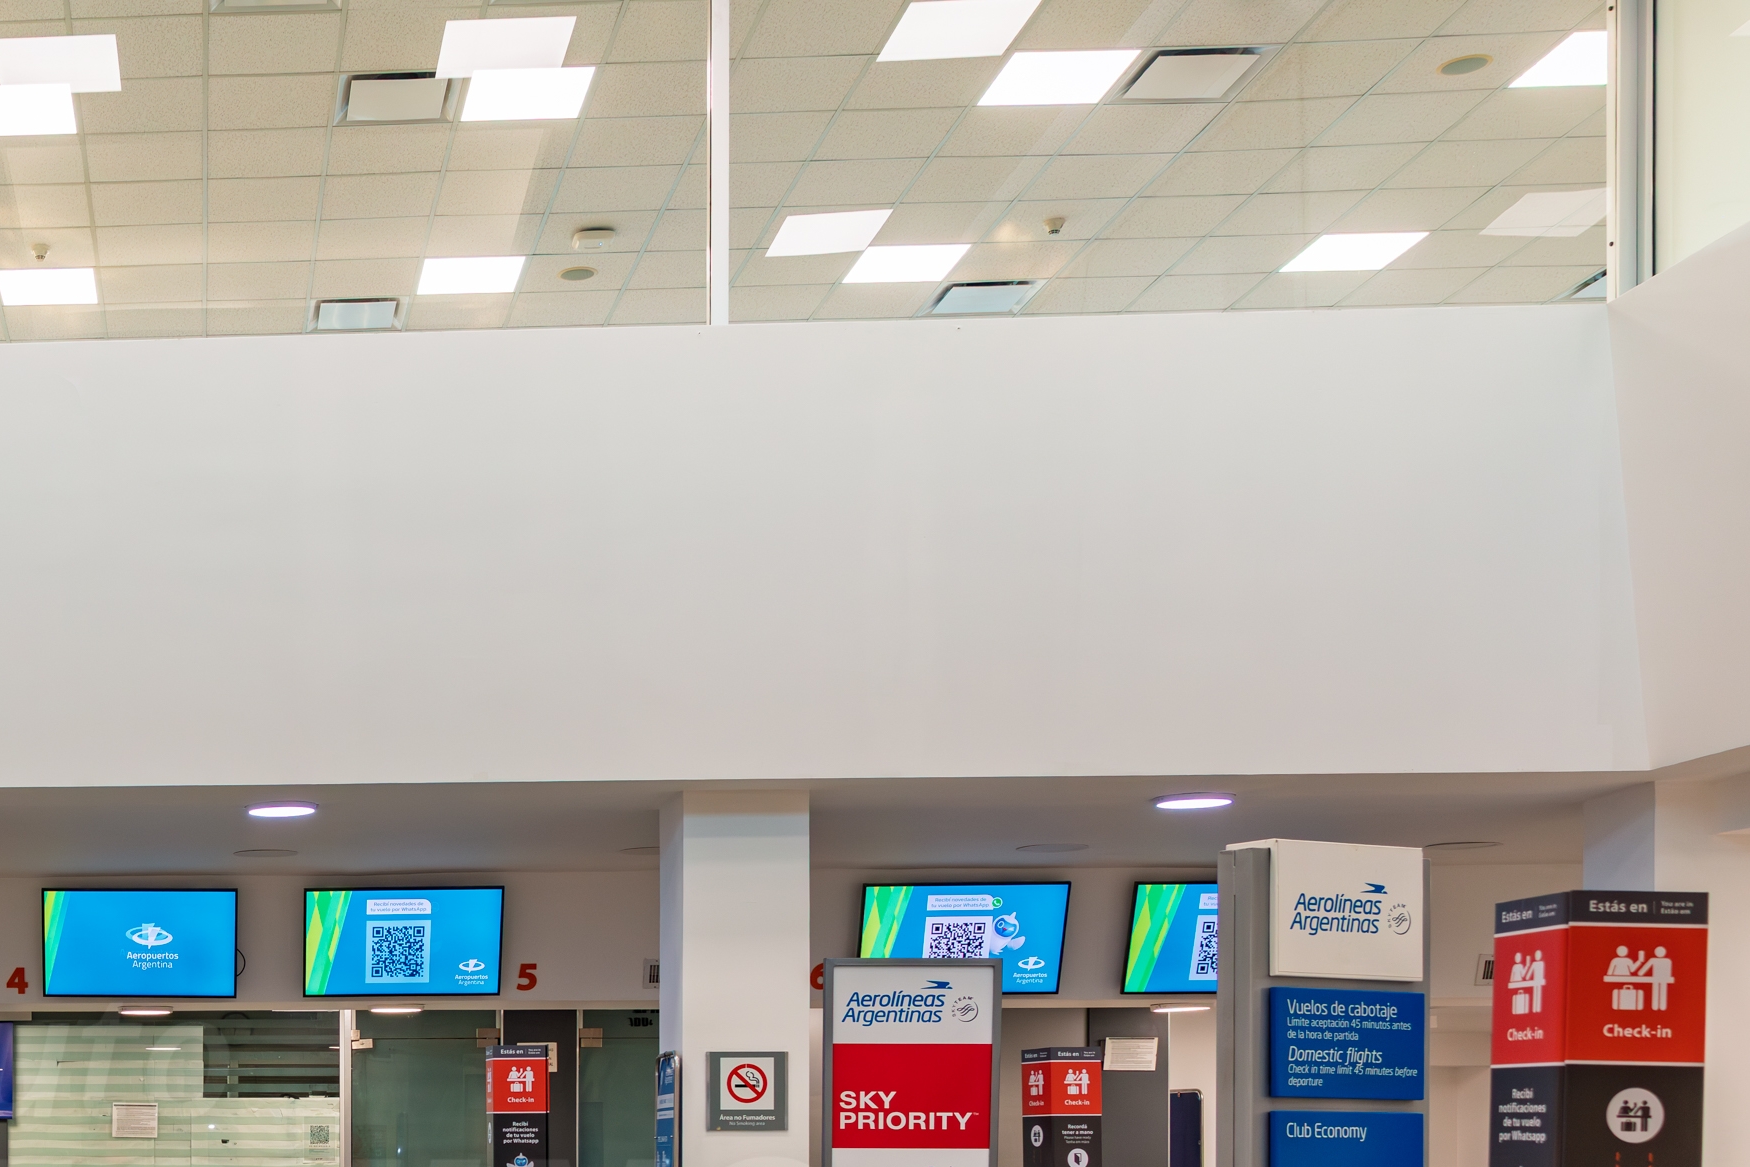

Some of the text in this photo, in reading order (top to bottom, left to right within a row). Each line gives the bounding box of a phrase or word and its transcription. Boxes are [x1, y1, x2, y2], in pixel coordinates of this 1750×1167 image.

[1294, 893, 1382, 915] Aerolíneas
[1589, 900, 1648, 913] Estás en
[1290, 912, 1380, 935] Argentinas
[1502, 910, 1521, 923] Estás
[1521, 909, 1532, 920] en
[127, 951, 179, 961] Aeropuertos
[132, 960, 173, 970] Argentina
[6, 967, 29, 994] 4
[516, 963, 538, 991] 5
[846, 990, 945, 1007] Aerolíneas
[841, 1008, 942, 1026] Argentinas
[1287, 998, 1398, 1021] Vuelos de cabotaje
[1311, 1018, 1349, 1029] aceptación
[1351, 1019, 1361, 1029] 45
[1362, 1020, 1391, 1030] minutos
[1392, 1021, 1411, 1031] antes
[1603, 1024, 1672, 1038] Check-in
[1287, 1029, 1359, 1041] de la hora de partida
[1507, 1025, 1544, 1041] Check-in
[1288, 1046, 1383, 1067] Domestic flights
[1288, 1063, 1418, 1078] Check in time limit 45 minutes before
[1288, 1076, 1323, 1087] departure
[839, 1090, 897, 1109] SKY
[1498, 1102, 1546, 1113] notificaciones
[839, 1111, 973, 1130] PRIORITY
[1286, 1122, 1367, 1142] Club Economy
